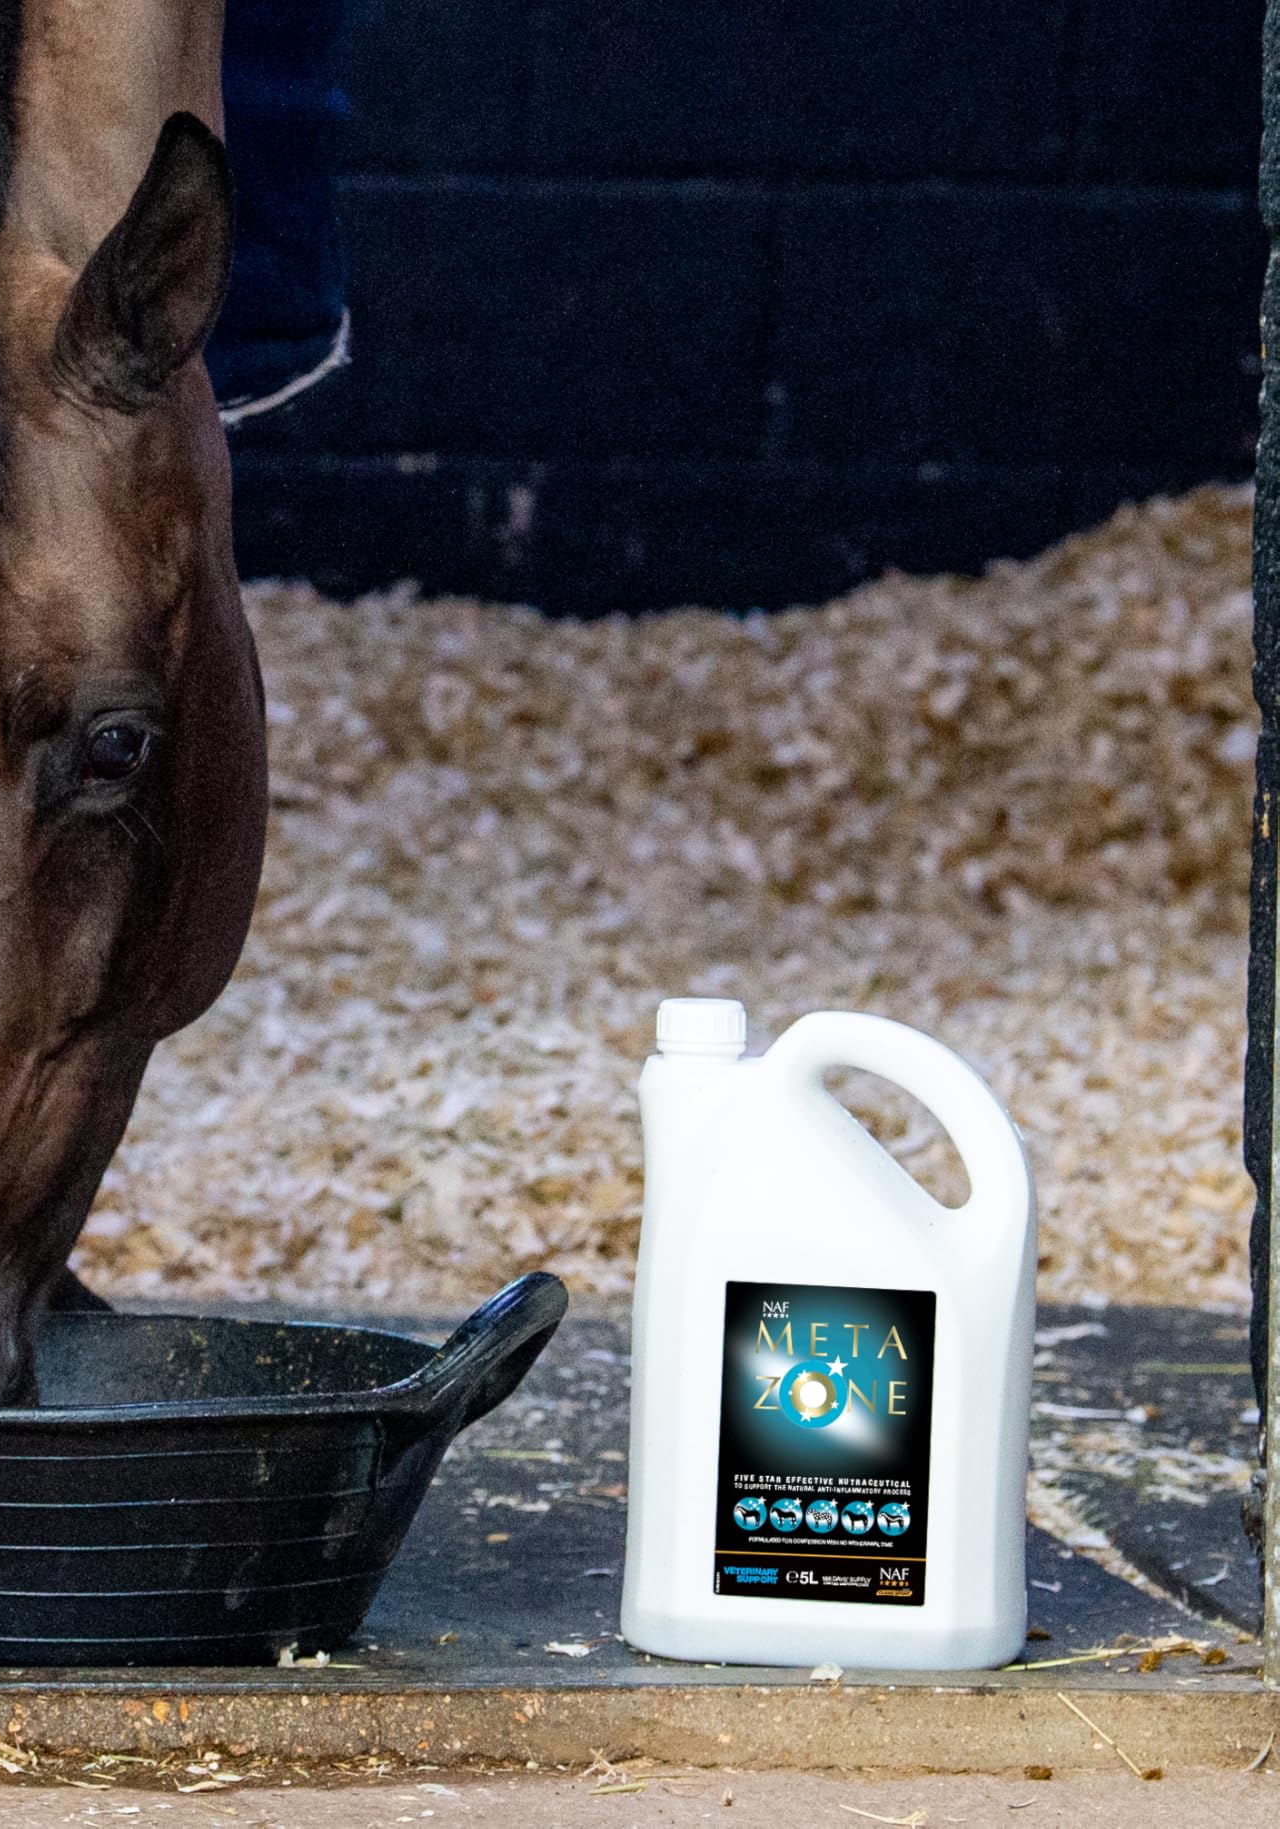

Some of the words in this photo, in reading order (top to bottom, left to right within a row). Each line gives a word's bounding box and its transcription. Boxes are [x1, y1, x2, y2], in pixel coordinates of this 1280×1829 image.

[762, 1301, 790, 1313] NAF
[755, 1320, 908, 1360] META
[753, 1371, 907, 1418] ZONE
[734, 1474, 755, 1482] FIVE
[759, 1475, 782, 1483] STAR
[785, 1476, 833, 1485] EFFECTIVE
[838, 1477, 911, 1488] NUTRACEUTICAL
[817, 1486, 881, 1494] ANTI-INFLAMMATORY
[883, 1488, 911, 1496] PROCESS
[723, 1566, 779, 1575] VETERINARY
[880, 1567, 909, 1580] NAF
[736, 1575, 778, 1584] SUPPORT
